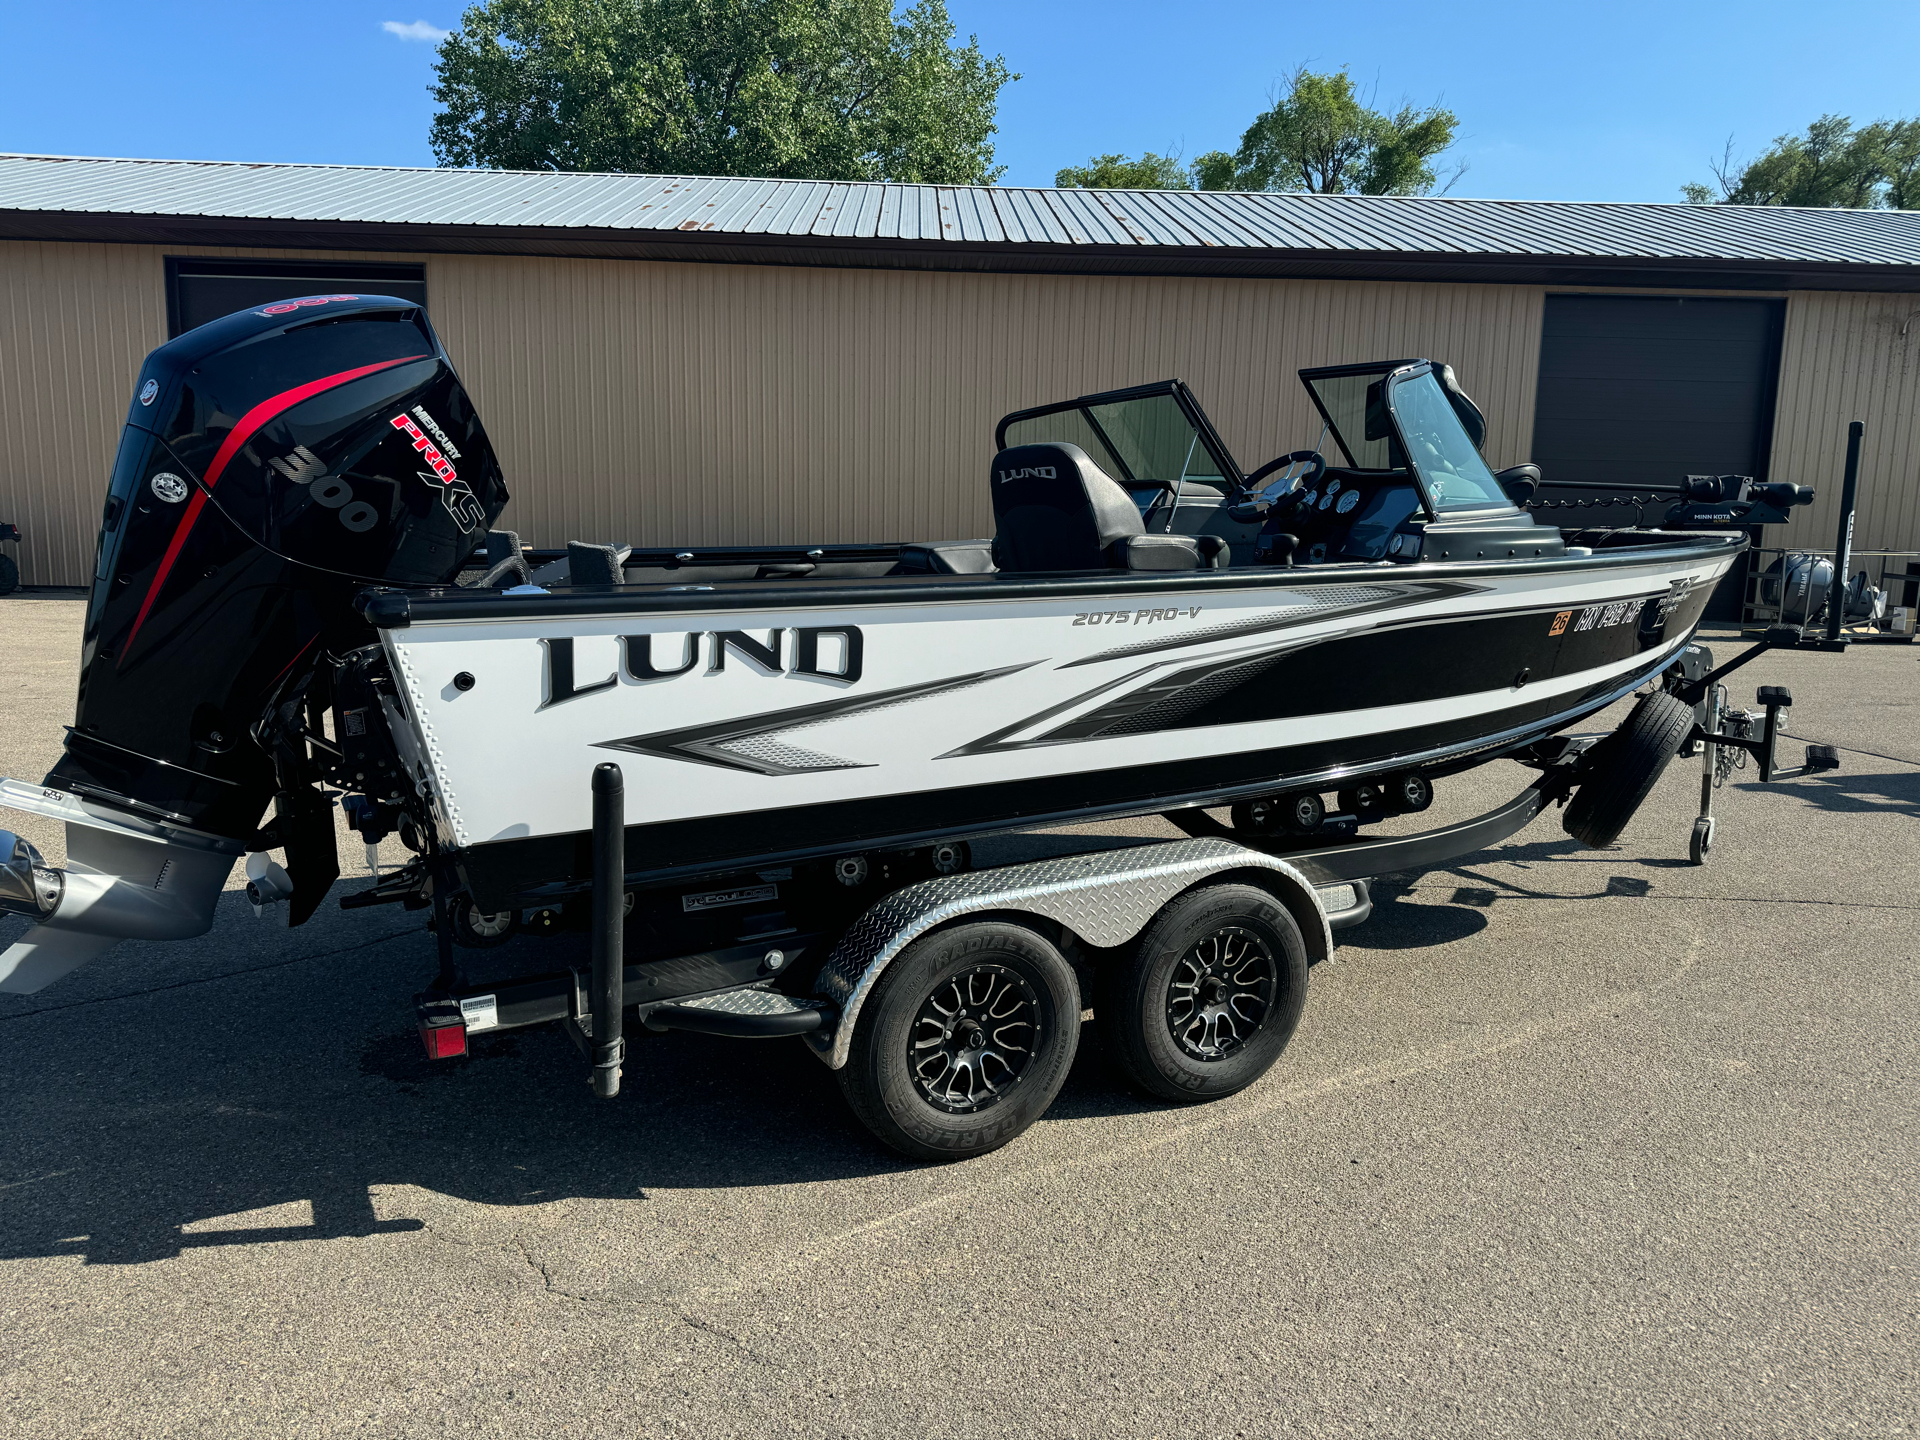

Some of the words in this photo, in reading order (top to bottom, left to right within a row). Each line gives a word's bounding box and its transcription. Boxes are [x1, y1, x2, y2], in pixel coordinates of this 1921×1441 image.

[389, 413, 457, 485] PRO
[411, 405, 461, 459] MERCURY
[269, 445, 378, 532] 300
[999, 466, 1057, 483] LUND
[416, 472, 486, 535] XS
[1798, 572, 1808, 597] YAMAHA
[1072, 611, 1130, 626] 2075
[1133, 606, 1202, 625] PRO-V
[1552, 616, 1568, 631] 26
[1573, 607, 1604, 632] MN
[535, 624, 866, 713] LUND
[931, 934, 1020, 970] RADIAL
[886, 1095, 1019, 1149] CARLISLE
